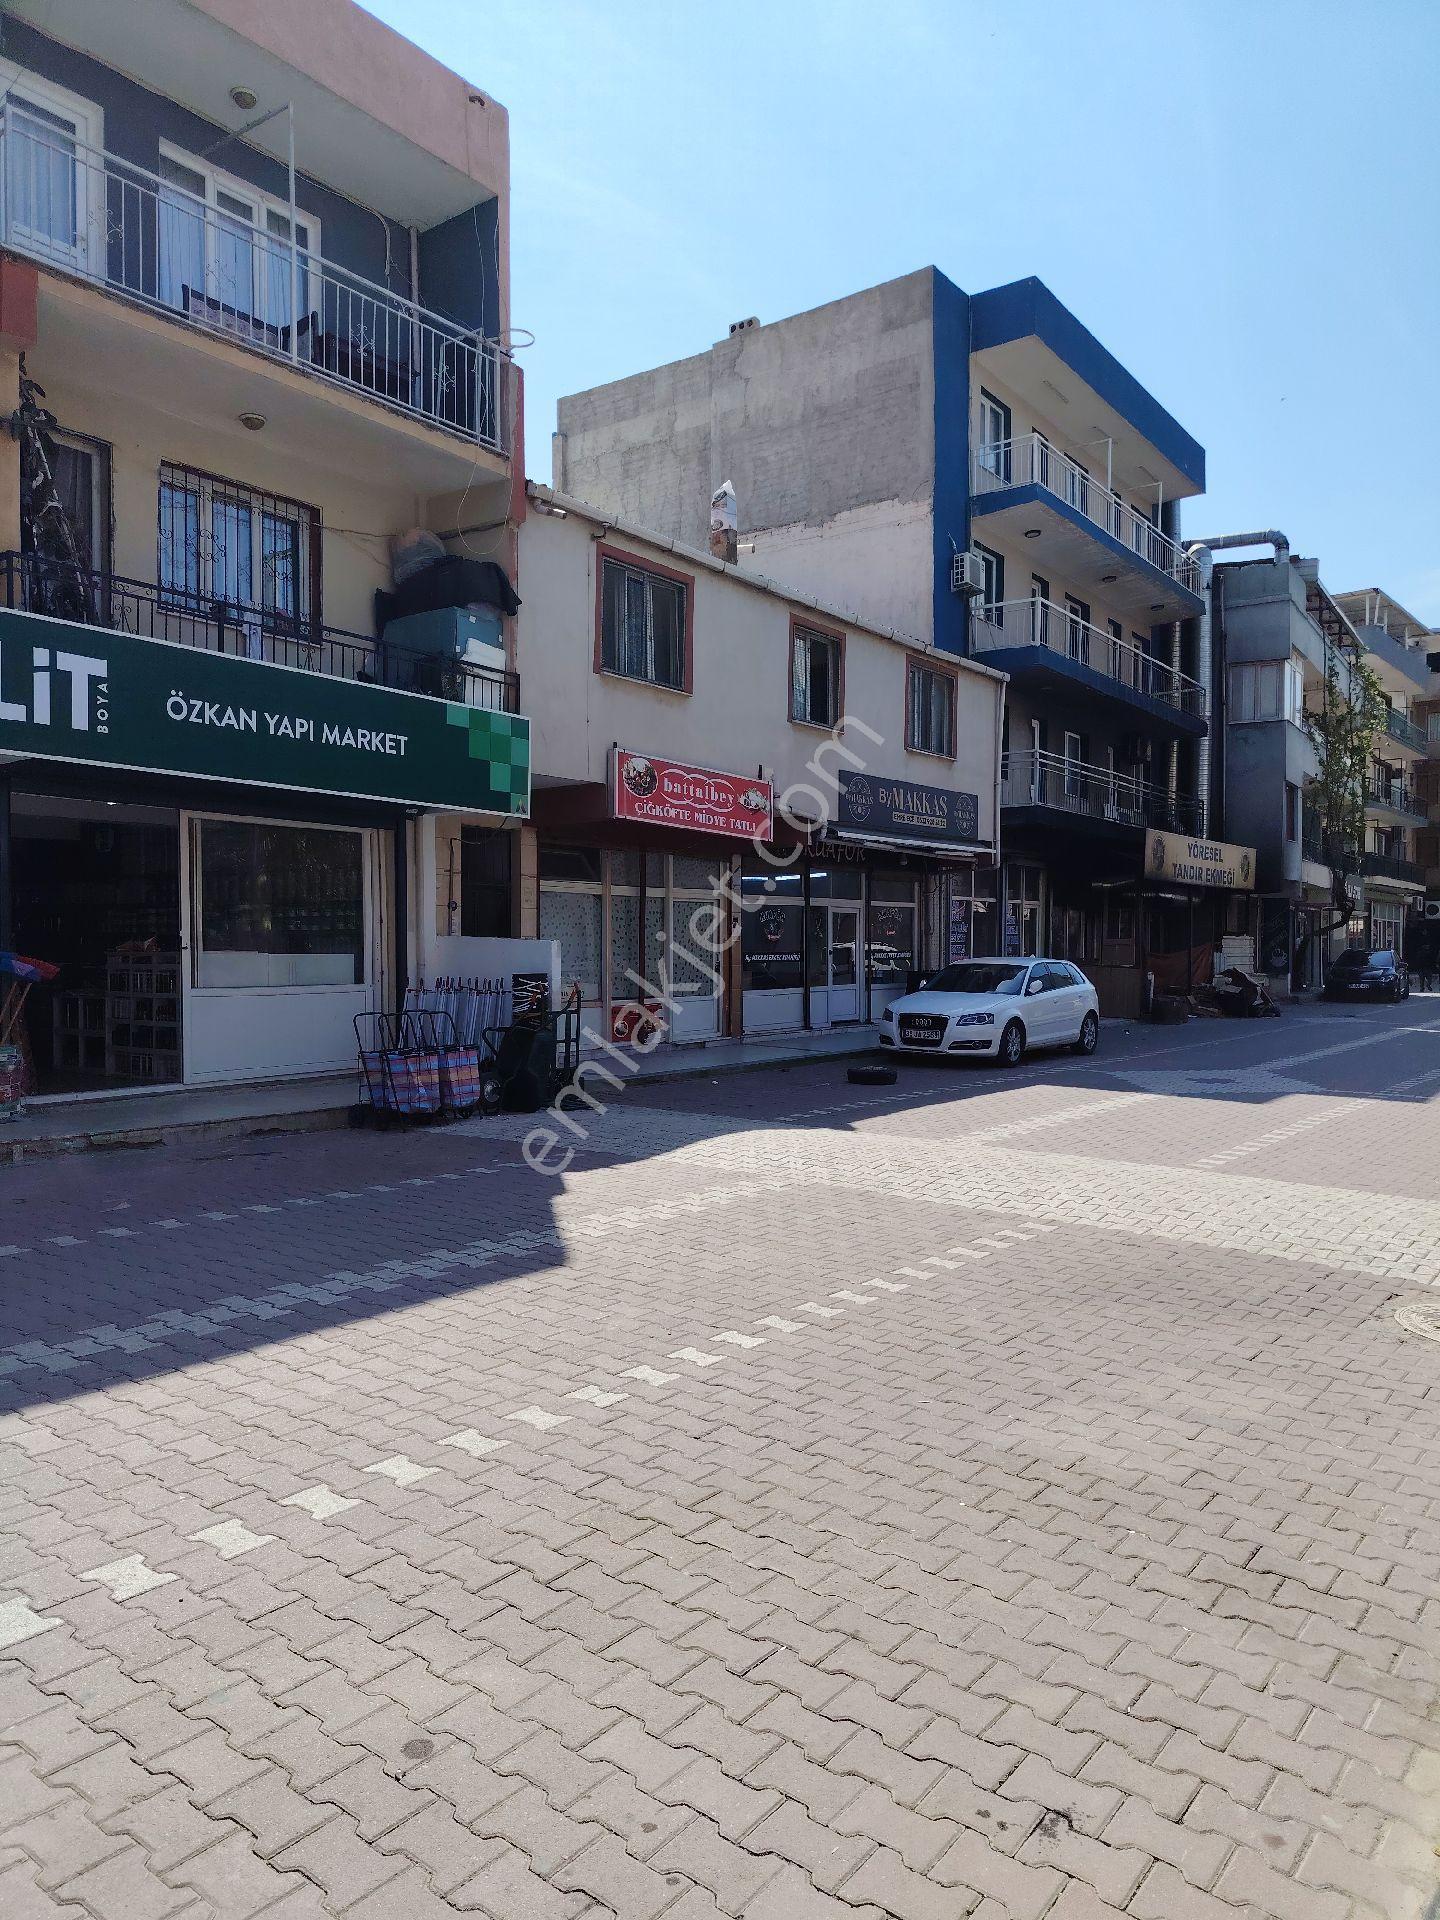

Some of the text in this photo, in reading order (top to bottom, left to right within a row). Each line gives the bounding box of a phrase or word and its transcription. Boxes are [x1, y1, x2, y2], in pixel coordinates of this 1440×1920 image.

[96, 683, 109, 734] BOYA
[166, 689, 409, 756] ÖZKAN YAPI MARKET
